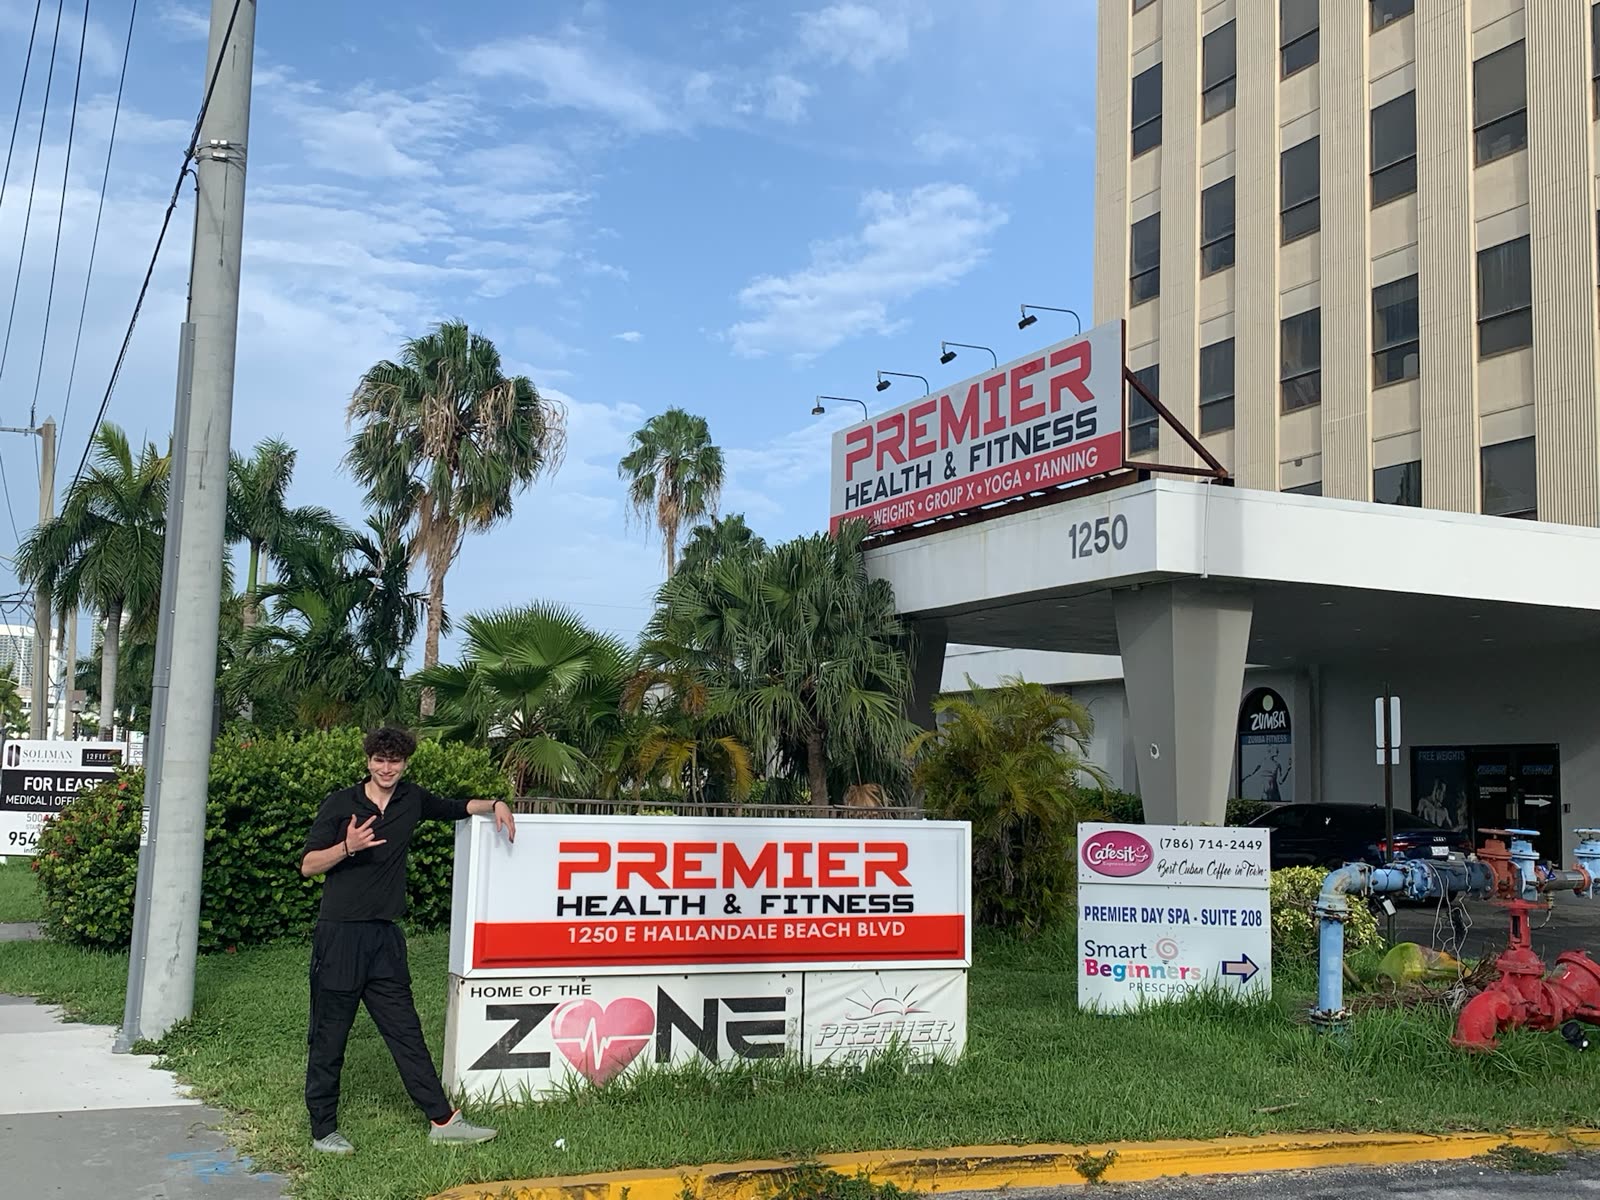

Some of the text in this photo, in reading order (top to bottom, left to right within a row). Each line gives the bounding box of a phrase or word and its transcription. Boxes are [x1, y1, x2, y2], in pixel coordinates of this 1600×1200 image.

[846, 340, 1095, 481] PREMIER
[846, 406, 1098, 510] HEALTH & FITNESS
[873, 446, 1098, 526] WEIGHTS GROUP X YOGA TANNING
[1068, 513, 1128, 559] 1250
[1250, 711, 1286, 731] ZUMBA
[1266, 735, 1287, 743] FITNESS
[22, 750, 73, 759] SOLIMAN
[1418, 751, 1466, 761] FREE WEIGHTS
[24, 777, 53, 791] FOR
[5, 795, 48, 806] MEDICAL
[1160, 838, 1263, 851] (786) 714-2449
[557, 841, 912, 890] PREMIER
[1157, 859, 1177, 878] Best
[1178, 859, 1204, 876] Cuban
[1206, 859, 1232, 880] Coffee
[1234, 864, 1242, 876] in
[557, 893, 915, 916] HEALTH & FITNESS
[1084, 906, 1137, 923] PREMIER
[1141, 907, 1164, 923] DAY
[1167, 908, 1190, 925] SPA
[1201, 909, 1237, 926] SUITE
[1241, 910, 1262, 926] 208
[568, 920, 906, 944] 1250 E HALLANDALE BEACH BLVD
[1085, 940, 1147, 959] Smart
[1085, 959, 1202, 982] Beginners
[470, 984, 592, 998] HOME OF THE
[815, 1020, 956, 1046] PREMIER
